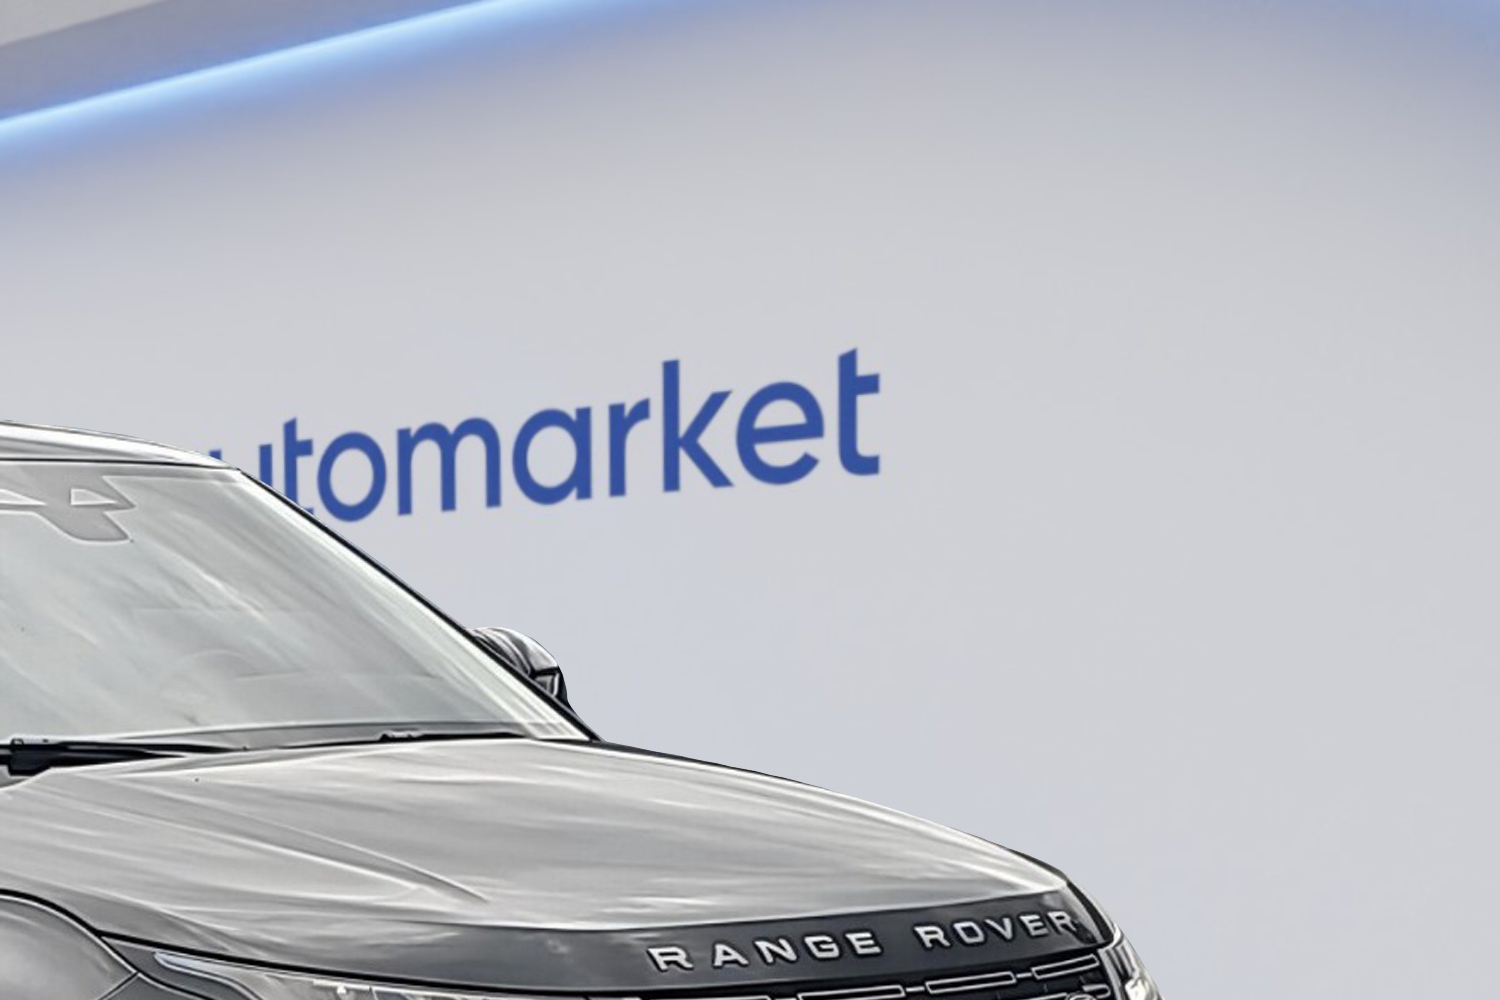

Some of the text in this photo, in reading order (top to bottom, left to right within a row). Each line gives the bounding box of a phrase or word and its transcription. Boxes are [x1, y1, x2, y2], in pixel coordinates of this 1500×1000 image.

[209, 348, 880, 522] tomarket
[647, 910, 1078, 971] RANGE ROVER
